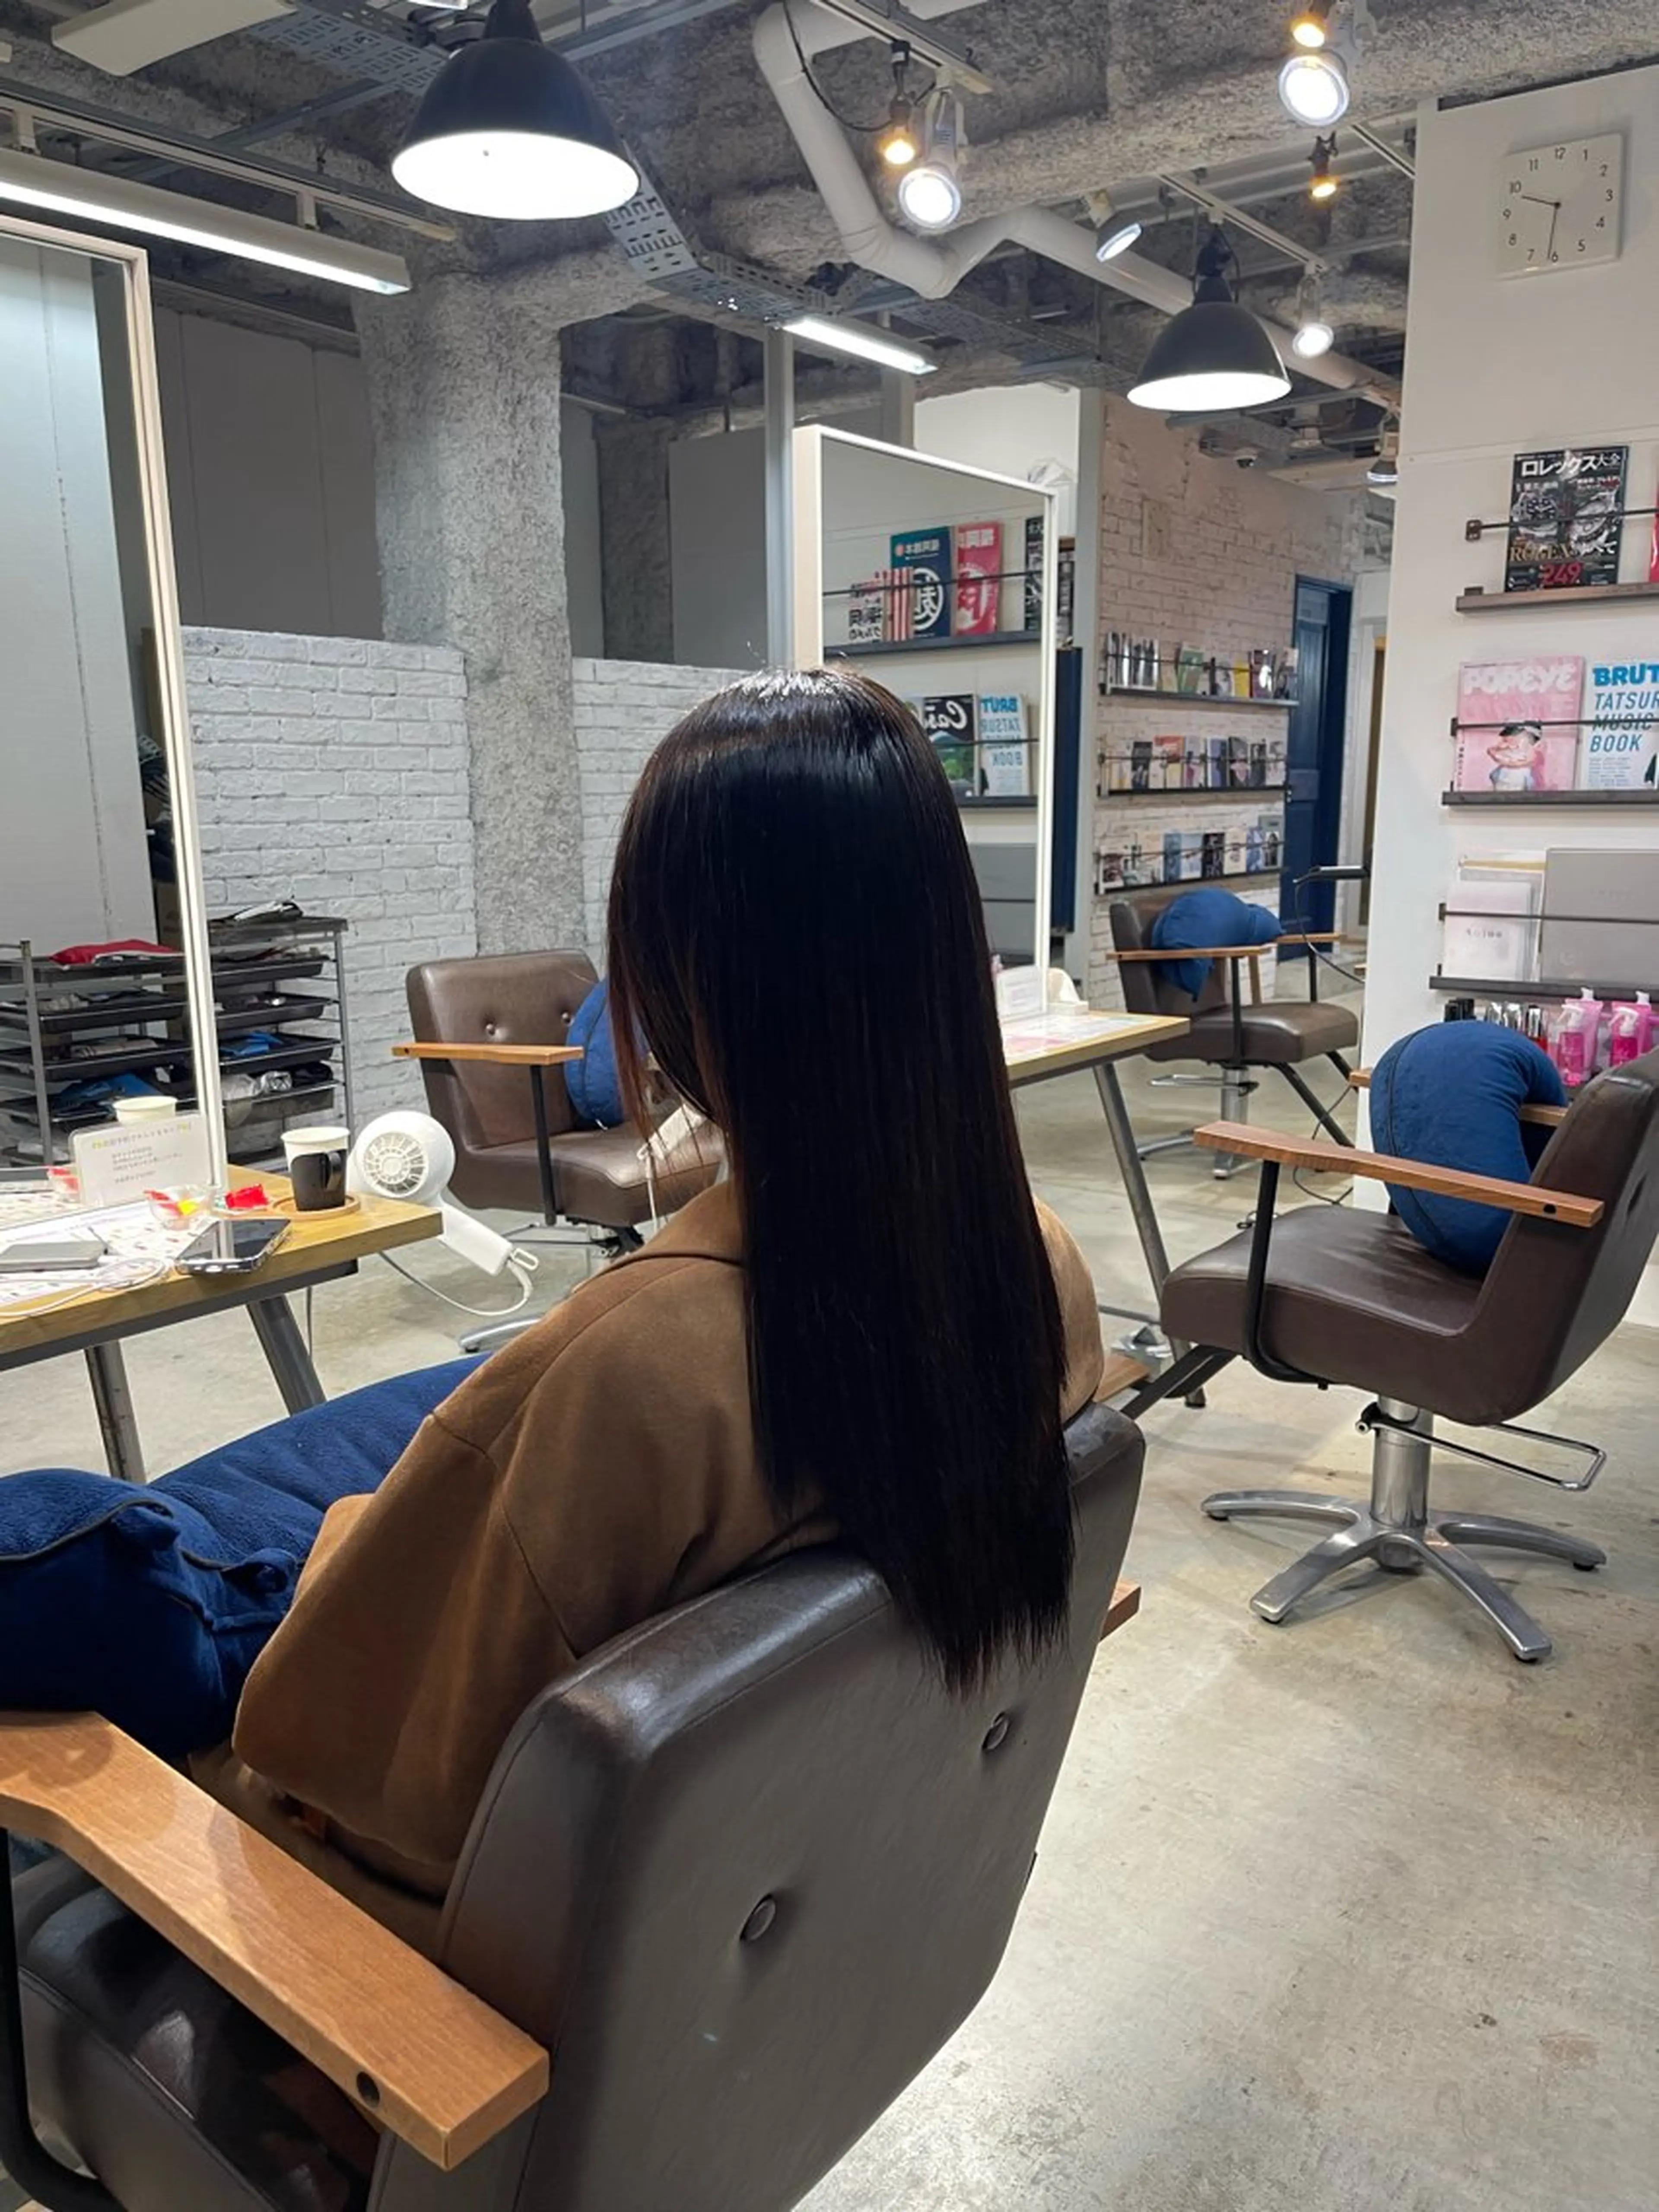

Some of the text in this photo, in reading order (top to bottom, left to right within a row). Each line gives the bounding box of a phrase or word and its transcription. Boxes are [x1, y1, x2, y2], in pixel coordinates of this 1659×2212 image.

[1554, 147, 1566, 159] 12
[1583, 149, 1588, 161] 1
[1529, 159, 1539, 171] 11
[1599, 165, 1608, 177] 2
[1510, 181, 1522, 194] 10
[1605, 189, 1613, 202] 3
[1503, 209, 1511, 220] 9
[1596, 216, 1605, 228] 4
[1509, 233, 1516, 246] 8
[1578, 239, 1586, 252] 5
[1527, 249, 1535, 261] 7
[1551, 251, 1559, 263] 6
[1464, 664, 1576, 695] POPEYE
[1592, 663, 1659, 686] BRUT
[1595, 691, 1659, 711] TATSUR
[1592, 712, 1654, 731] MUSIC
[1589, 734, 1642, 753] BOOK
